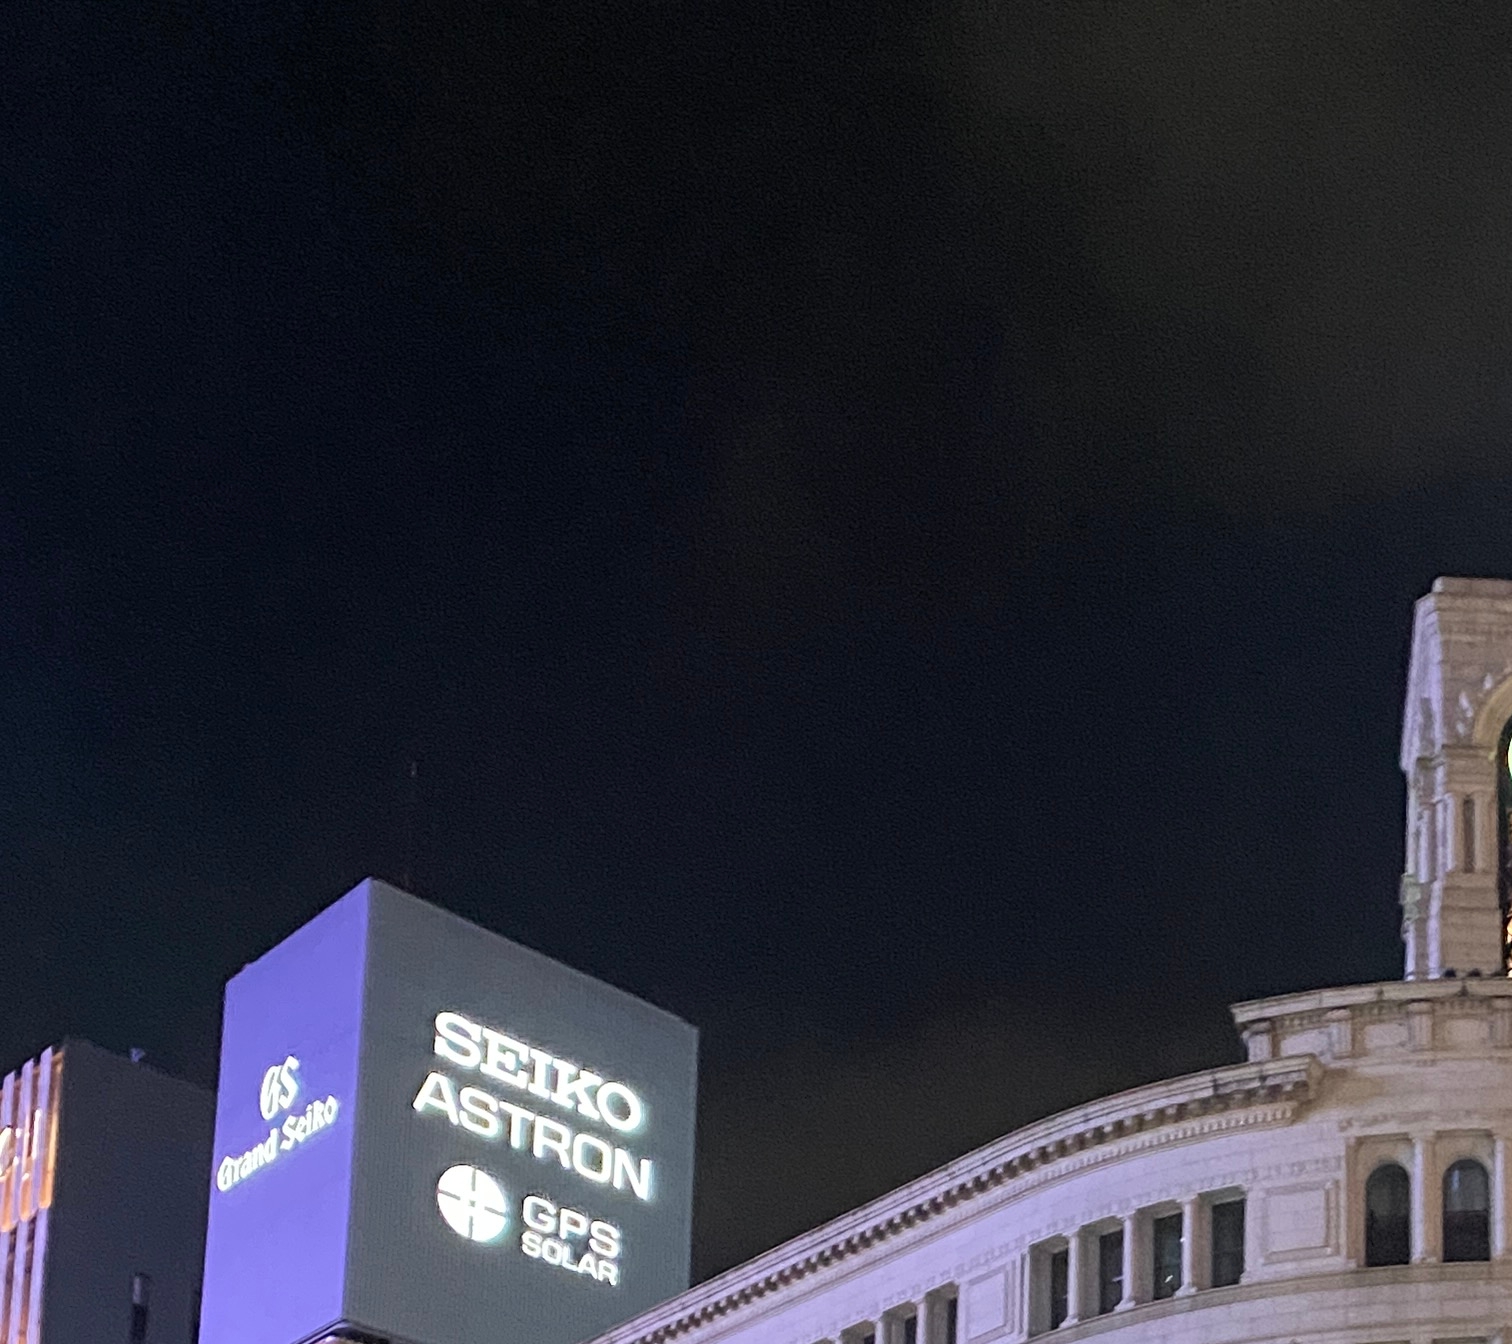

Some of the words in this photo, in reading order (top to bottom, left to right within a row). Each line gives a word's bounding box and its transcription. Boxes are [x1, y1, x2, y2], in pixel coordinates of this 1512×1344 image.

[433, 1011, 645, 1132] SEIKO
[216, 1130, 277, 1192] Grand
[281, 1095, 339, 1151] Seiko
[413, 1071, 653, 1200] ASTRON
[521, 1231, 619, 1286] SOLAR
[522, 1194, 621, 1258] GPS
